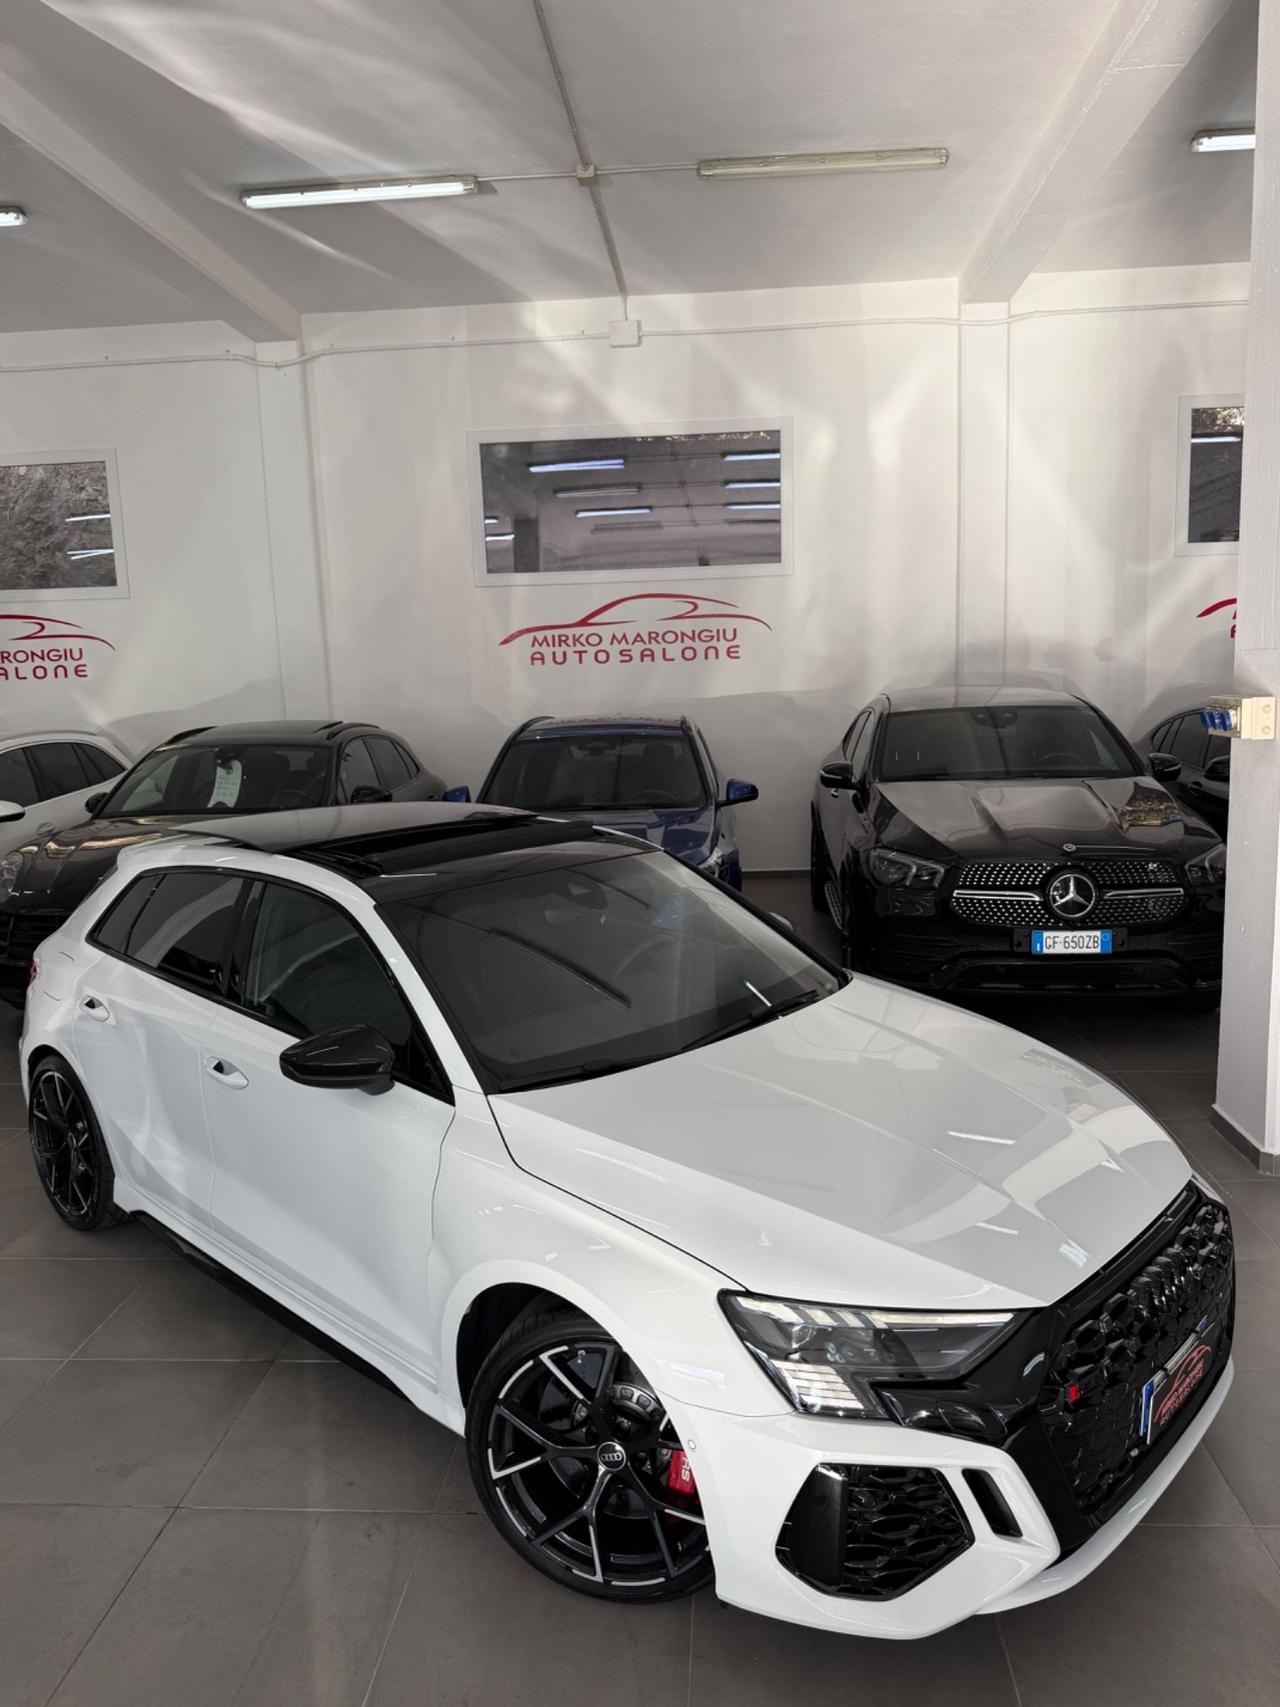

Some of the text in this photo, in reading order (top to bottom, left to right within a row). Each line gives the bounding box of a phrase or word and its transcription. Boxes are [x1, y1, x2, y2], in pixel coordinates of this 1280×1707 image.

[531, 627, 737, 648] MIRKO MARONGIU
[530, 645, 741, 666] AUTOSALONE
